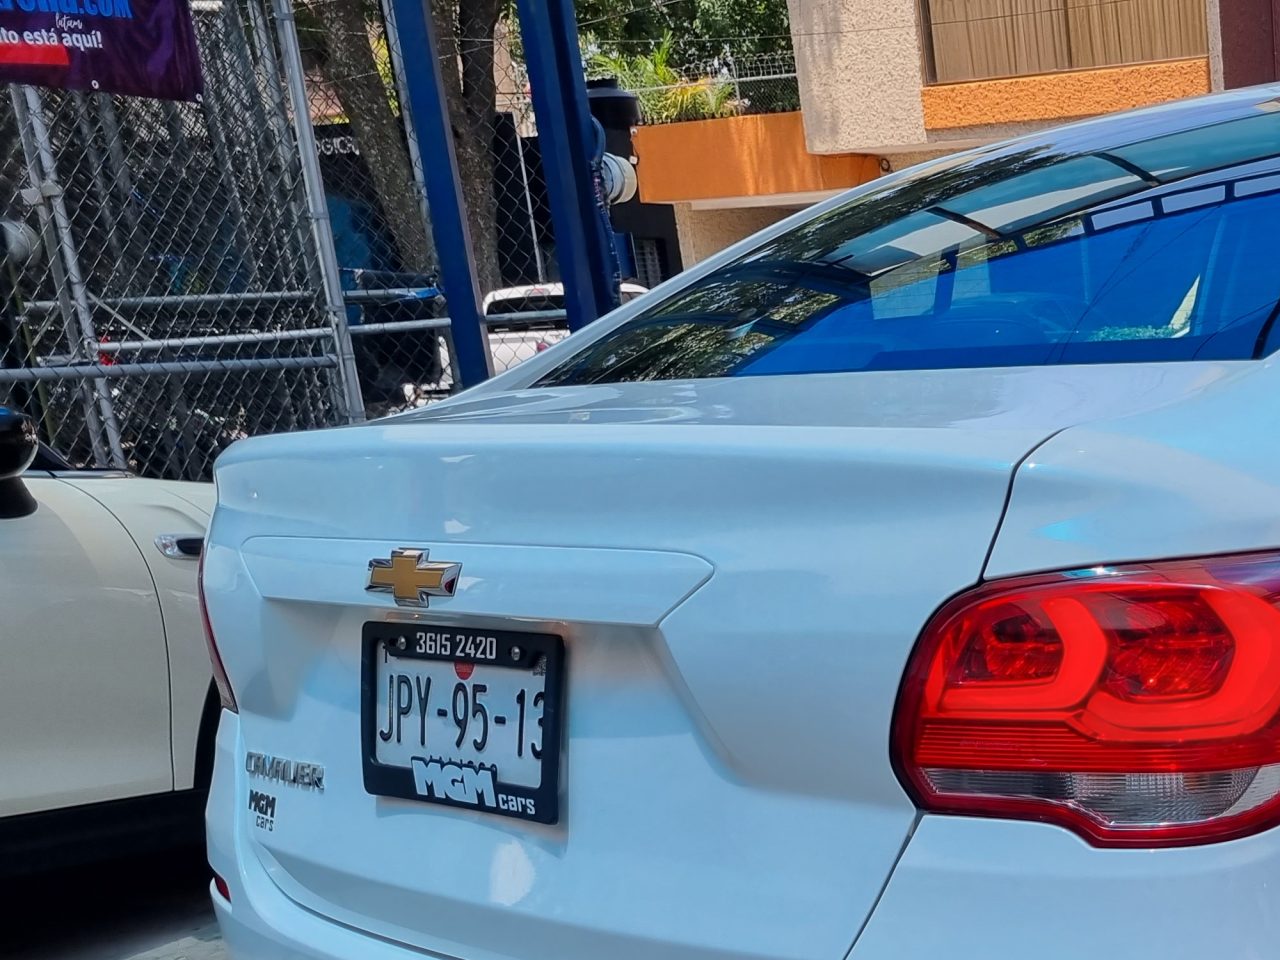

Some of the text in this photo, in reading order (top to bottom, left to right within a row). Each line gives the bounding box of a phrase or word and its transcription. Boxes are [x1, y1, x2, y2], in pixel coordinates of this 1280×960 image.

[56, 12, 83, 31] latam
[0, 26, 103, 51] to está aquí!
[416, 632, 451, 656] 3615
[455, 635, 497, 660] 2420
[379, 674, 545, 760] JPY-95-13
[411, 758, 497, 808] MGM
[498, 793, 536, 815] cars
[248, 789, 277, 819] MGM
[256, 815, 274, 832] cars
